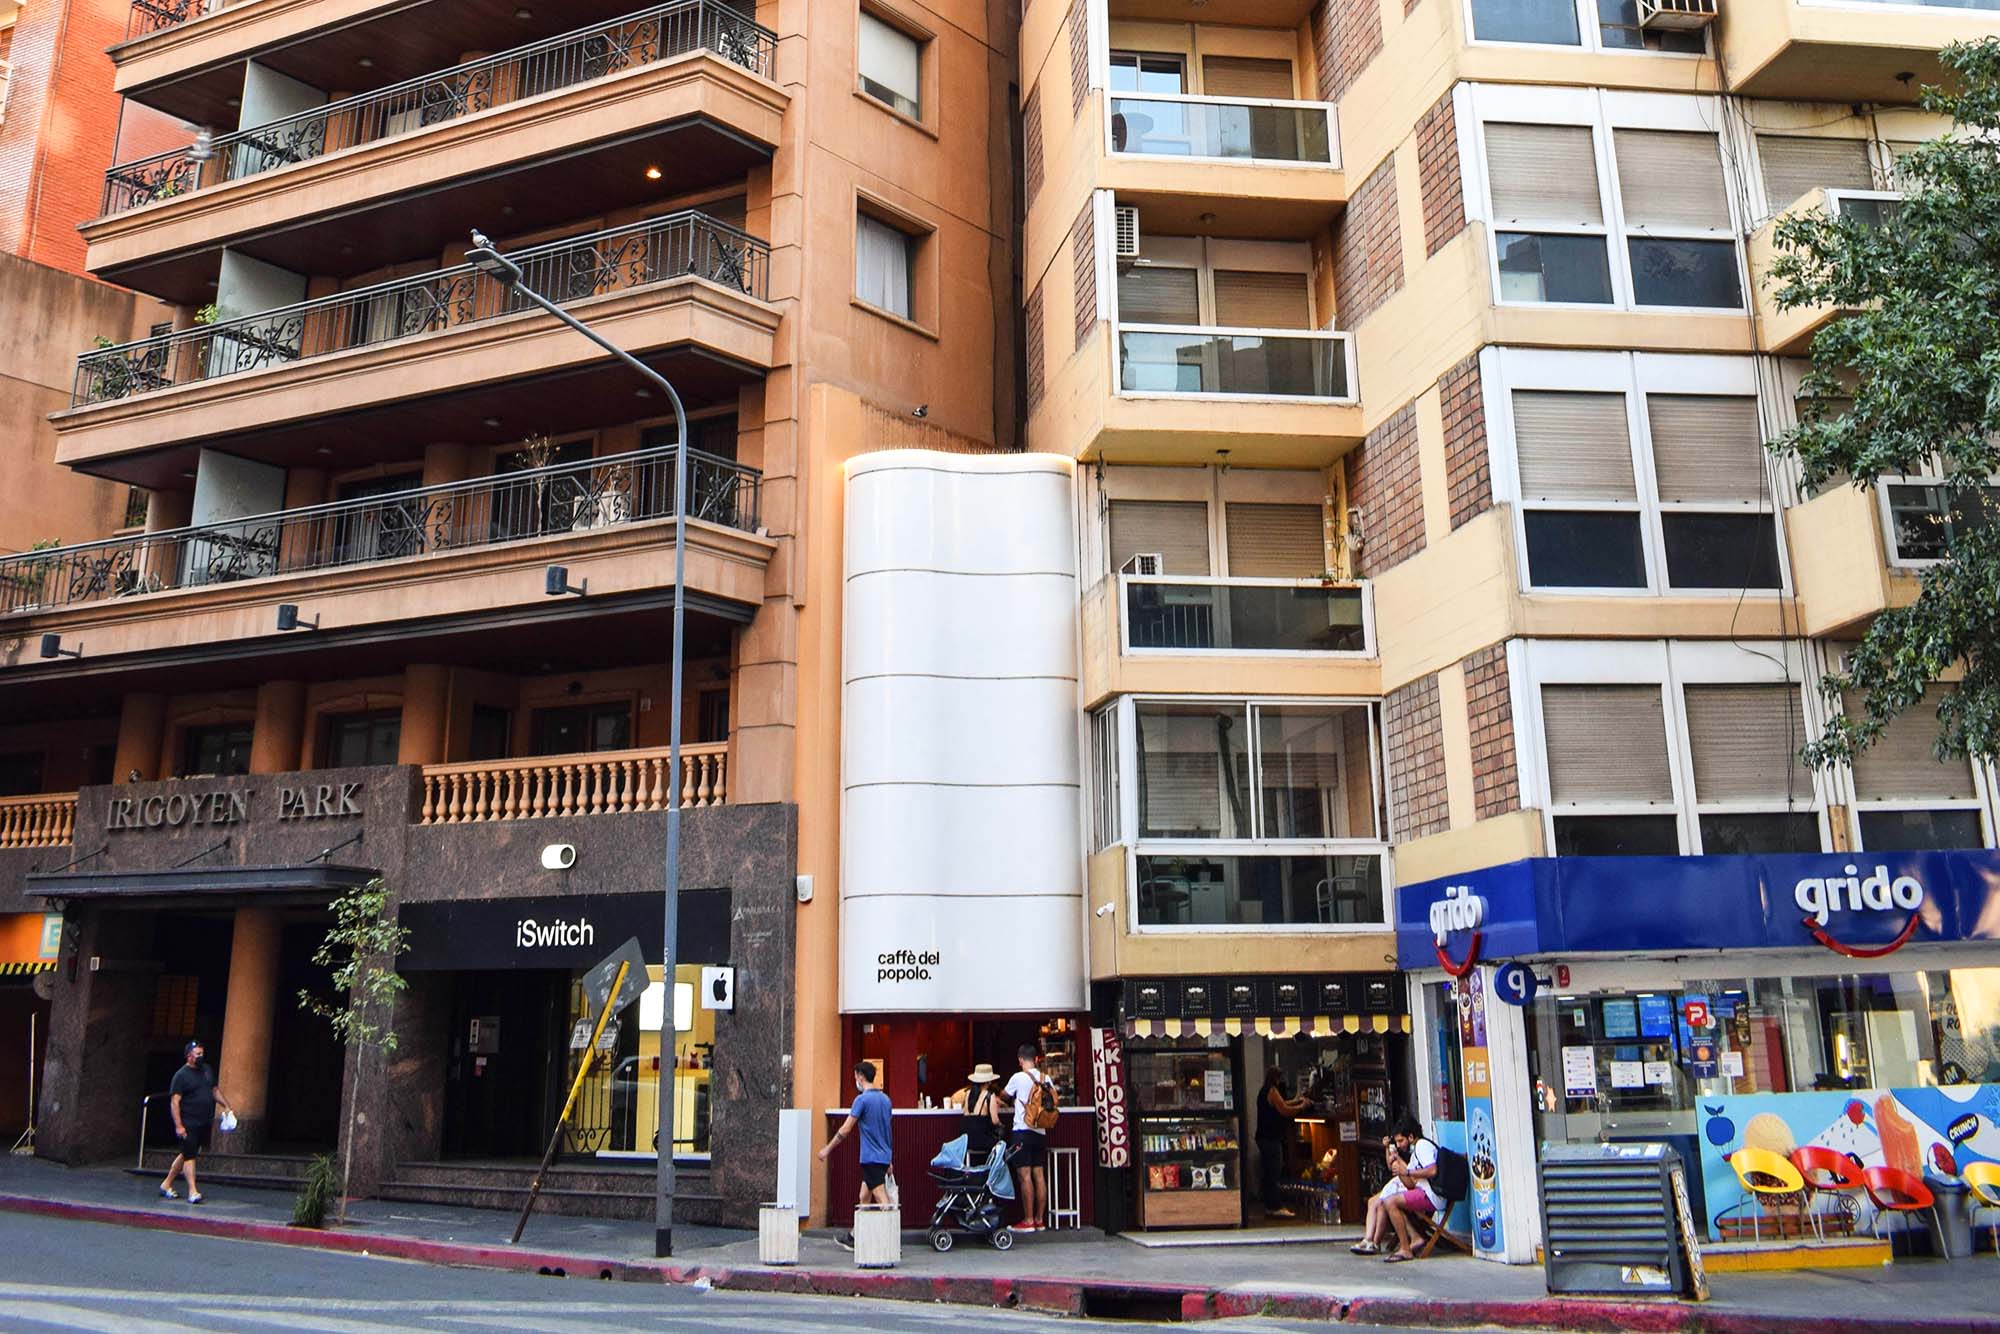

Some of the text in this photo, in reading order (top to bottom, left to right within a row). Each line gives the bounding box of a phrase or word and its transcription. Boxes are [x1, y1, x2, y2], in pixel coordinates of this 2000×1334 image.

[104, 782, 362, 830] IRIGOYEN PARK
[1794, 863, 1924, 927] grido
[516, 917, 594, 948] iSwitch
[1429, 885, 1483, 947] grido
[878, 949, 940, 965] caffè del
[878, 965, 932, 984] popolo.
[1507, 969, 1526, 999] g
[1093, 1048, 1109, 1165] KIOSCO
[1105, 1047, 1128, 1167] KIOSCO
[1949, 1116, 1978, 1141] CRUNCH
